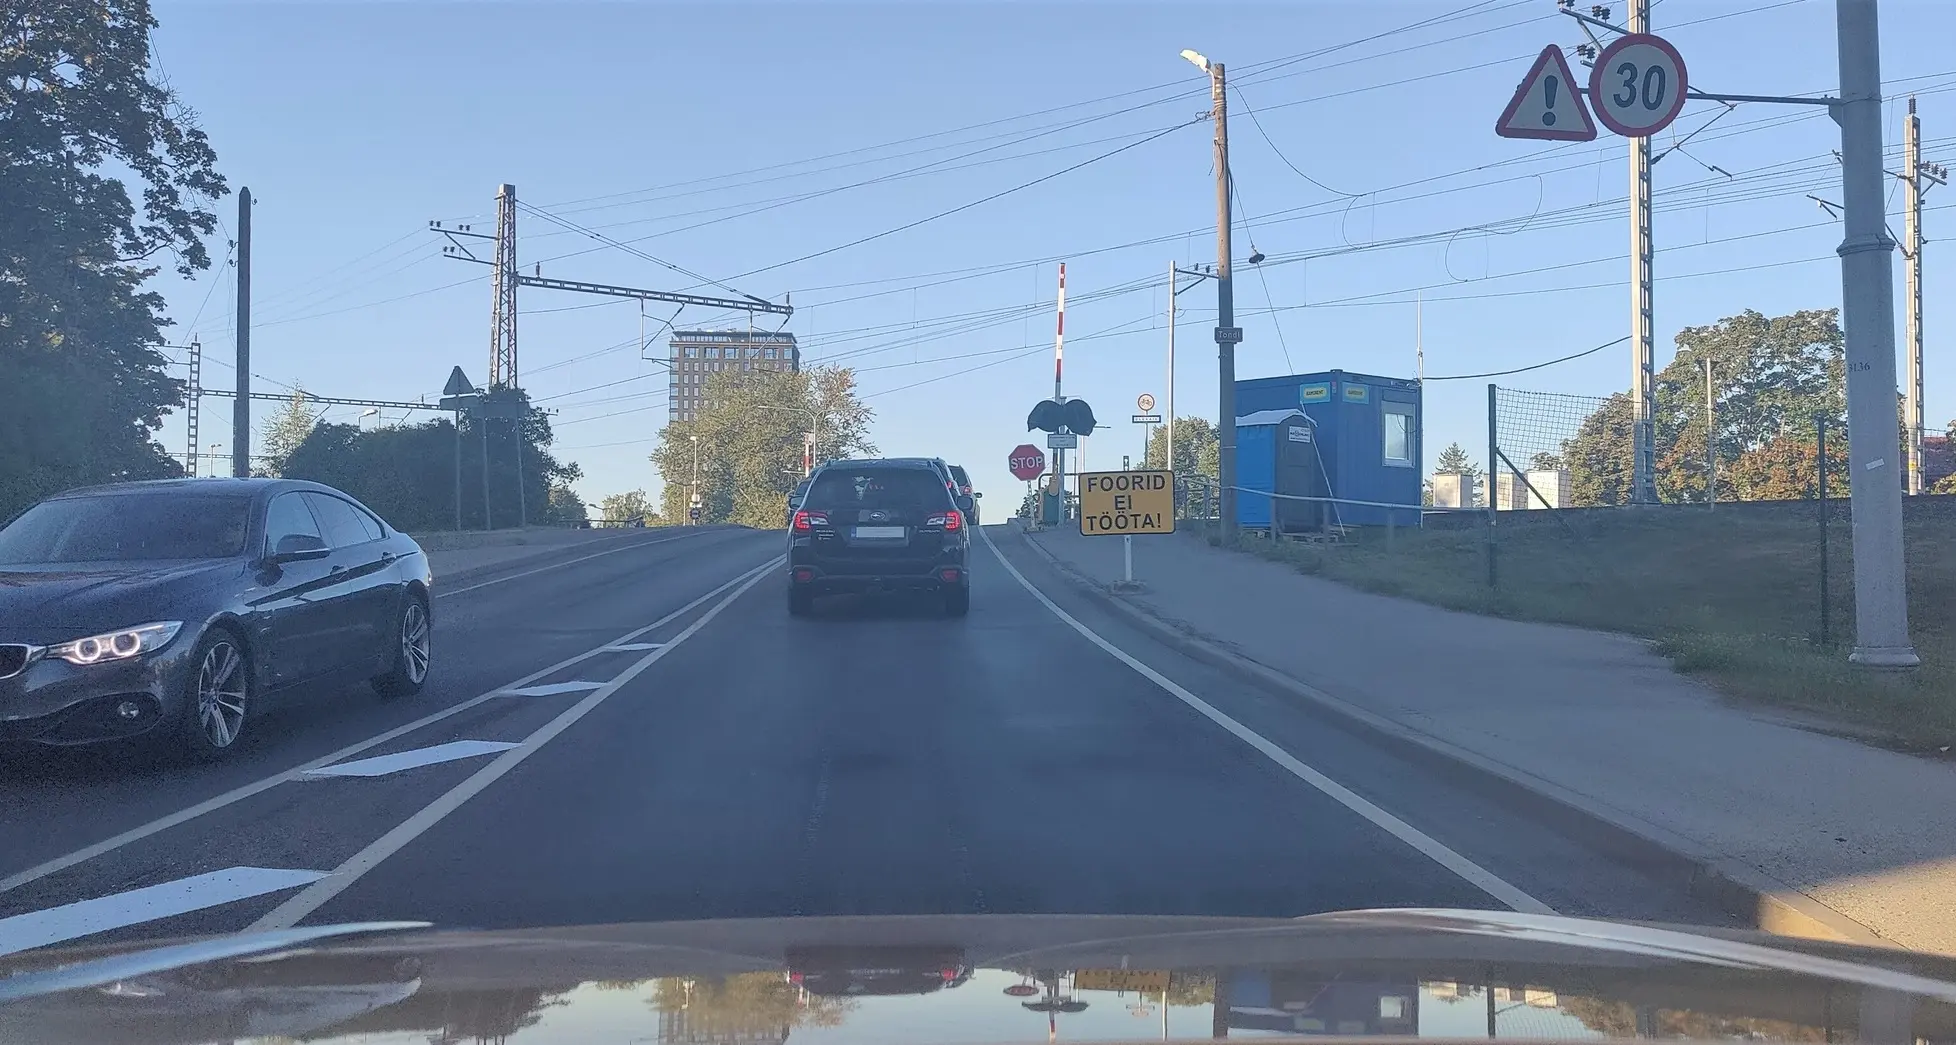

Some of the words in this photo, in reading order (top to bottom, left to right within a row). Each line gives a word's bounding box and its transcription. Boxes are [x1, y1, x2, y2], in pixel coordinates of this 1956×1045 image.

[1613, 61, 1665, 111] 30
[1010, 456, 1044, 470] STOP
[1087, 474, 1166, 492] FOORID
[1114, 495, 1132, 511] EI
[1086, 511, 1161, 531] TÖÖTA!
